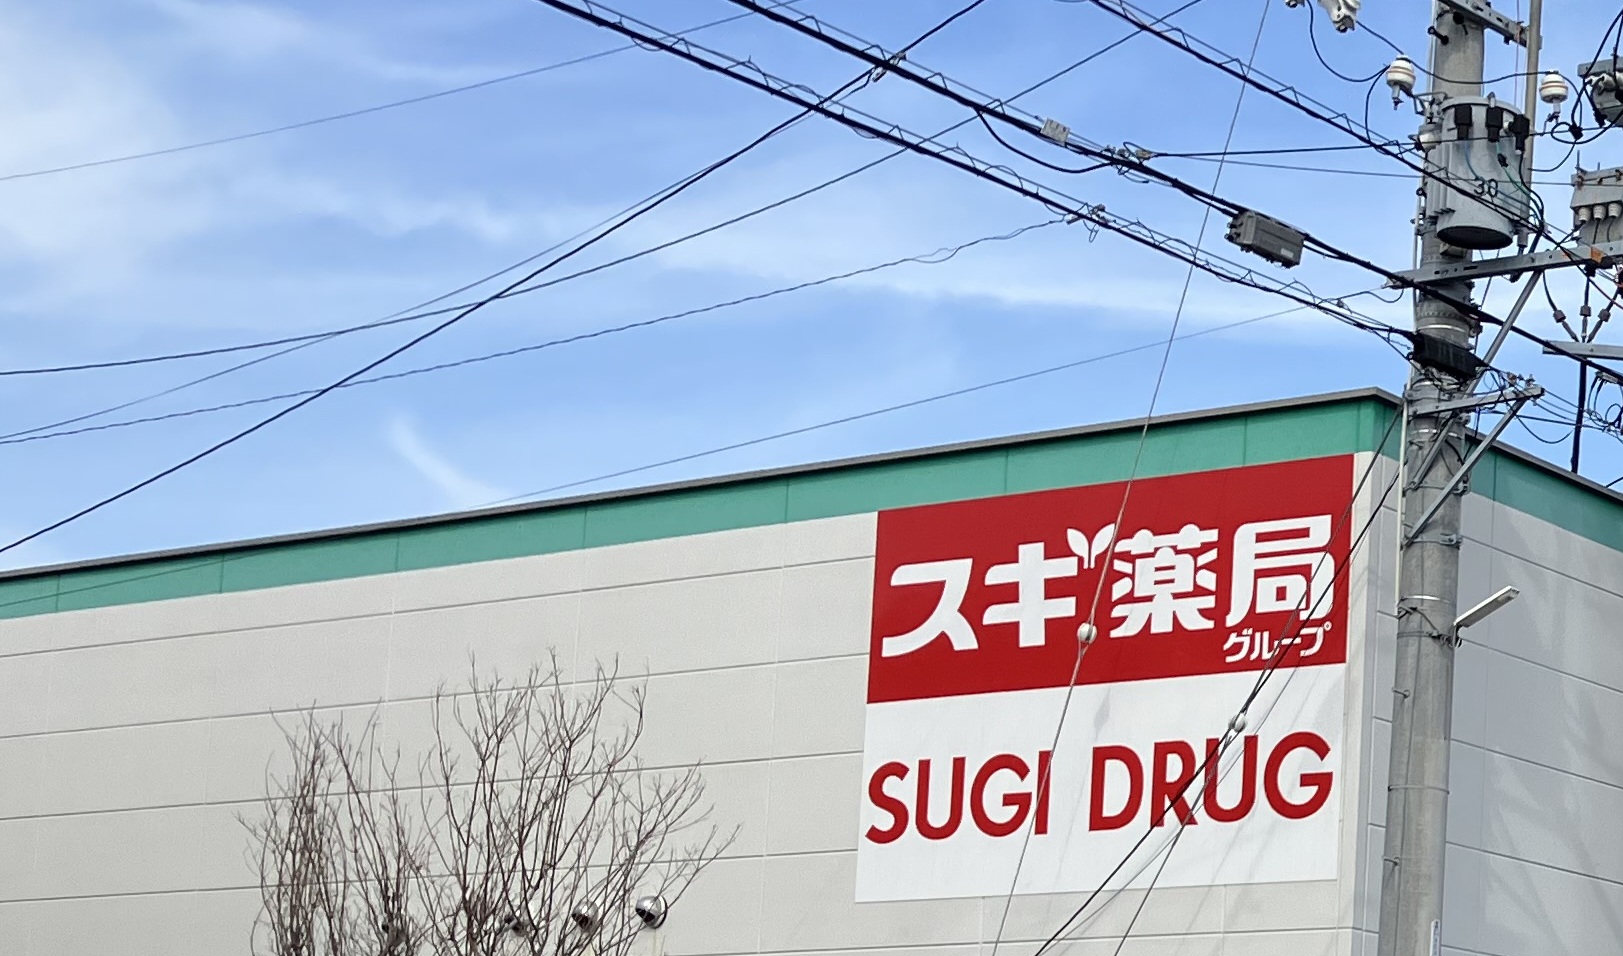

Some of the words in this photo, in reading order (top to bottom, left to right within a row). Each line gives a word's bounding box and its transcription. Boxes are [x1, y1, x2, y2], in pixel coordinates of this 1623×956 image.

[881, 514, 1337, 658] スギ薬局
[1223, 621, 1333, 663] グループ
[865, 750, 1053, 844] SUGI
[1088, 731, 1334, 831] DRUG
